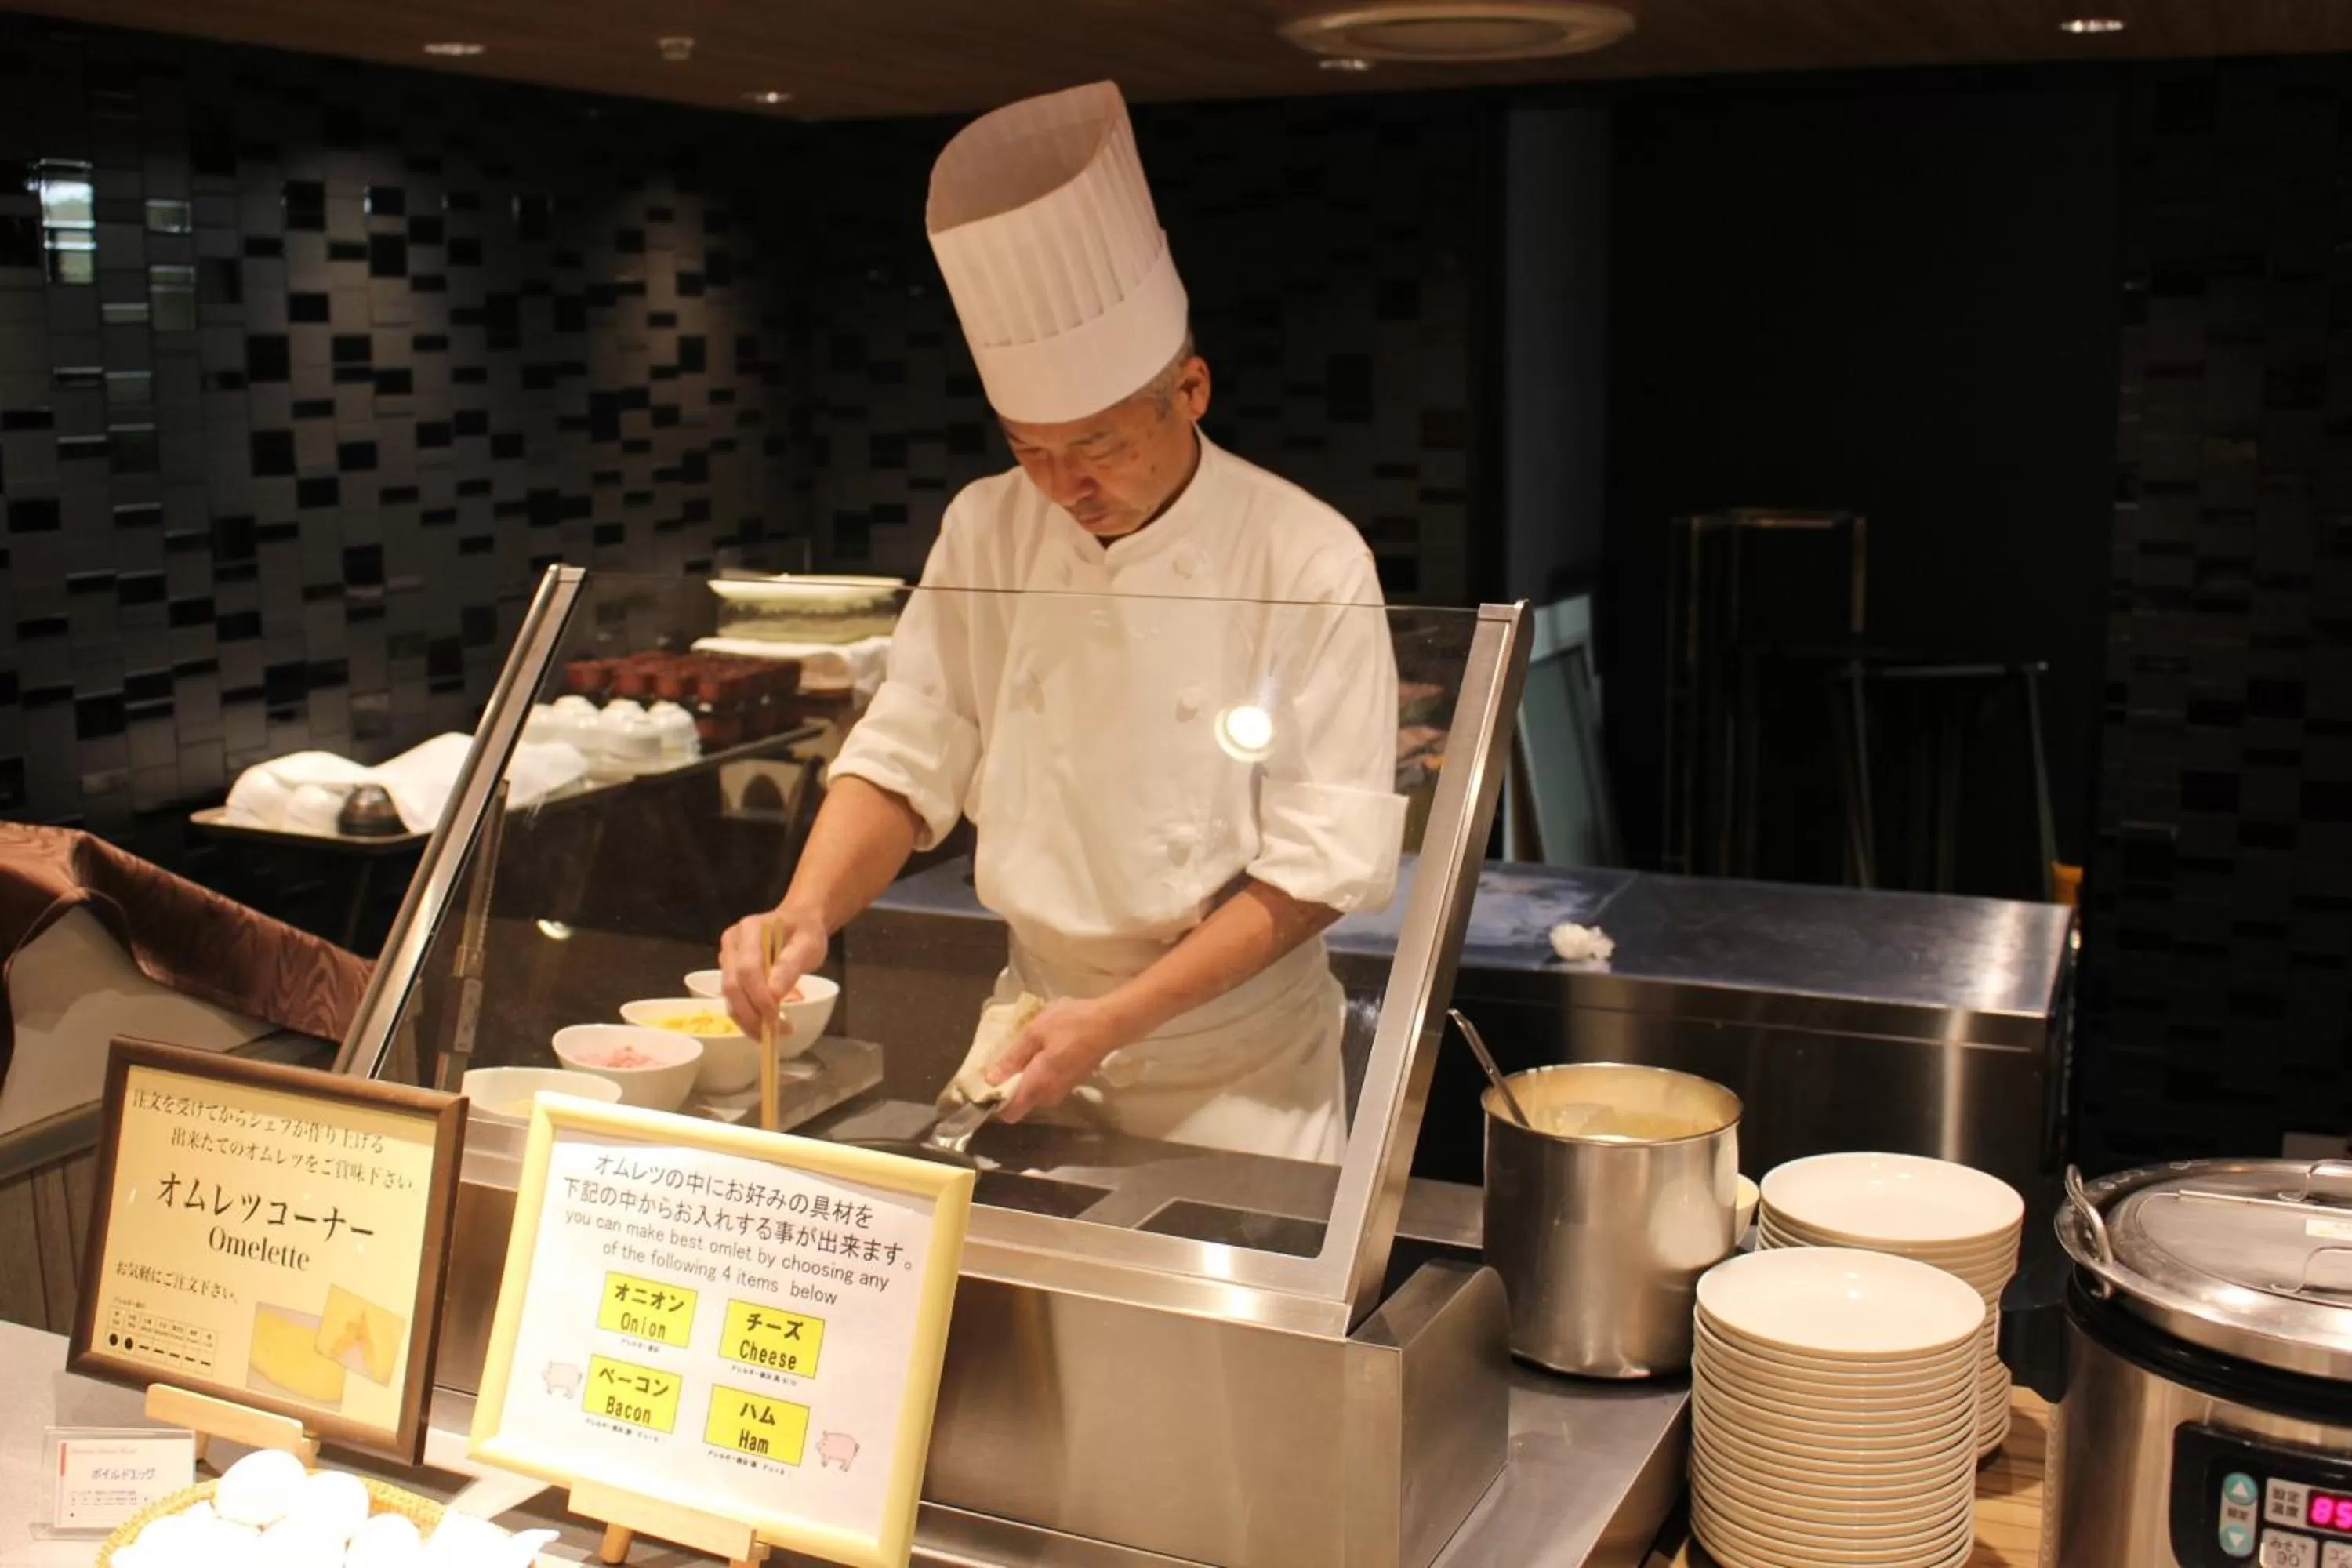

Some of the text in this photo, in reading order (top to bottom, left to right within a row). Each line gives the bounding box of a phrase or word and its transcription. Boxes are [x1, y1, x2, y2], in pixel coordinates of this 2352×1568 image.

[157, 1171, 375, 1243] オムレツコーナー
[593, 1154, 874, 1229] オムレツの中にお好みの具材を
[564, 1176, 913, 1271] 下記の中からお入れする事が出来ます。
[208, 1225, 310, 1272] Omelette
[565, 1210, 890, 1293] you can make best omlet by choosing any
[603, 1240, 838, 1305] of the following 4 items below
[614, 1283, 685, 1312] オニオン
[620, 1311, 666, 1340] Onion
[746, 1312, 804, 1341] チーズ
[739, 1339, 797, 1371] Cheese
[598, 1367, 669, 1397] ベーコン
[605, 1395, 652, 1425] Bacon
[739, 1402, 775, 1426] ハム
[738, 1428, 770, 1455] Ham
